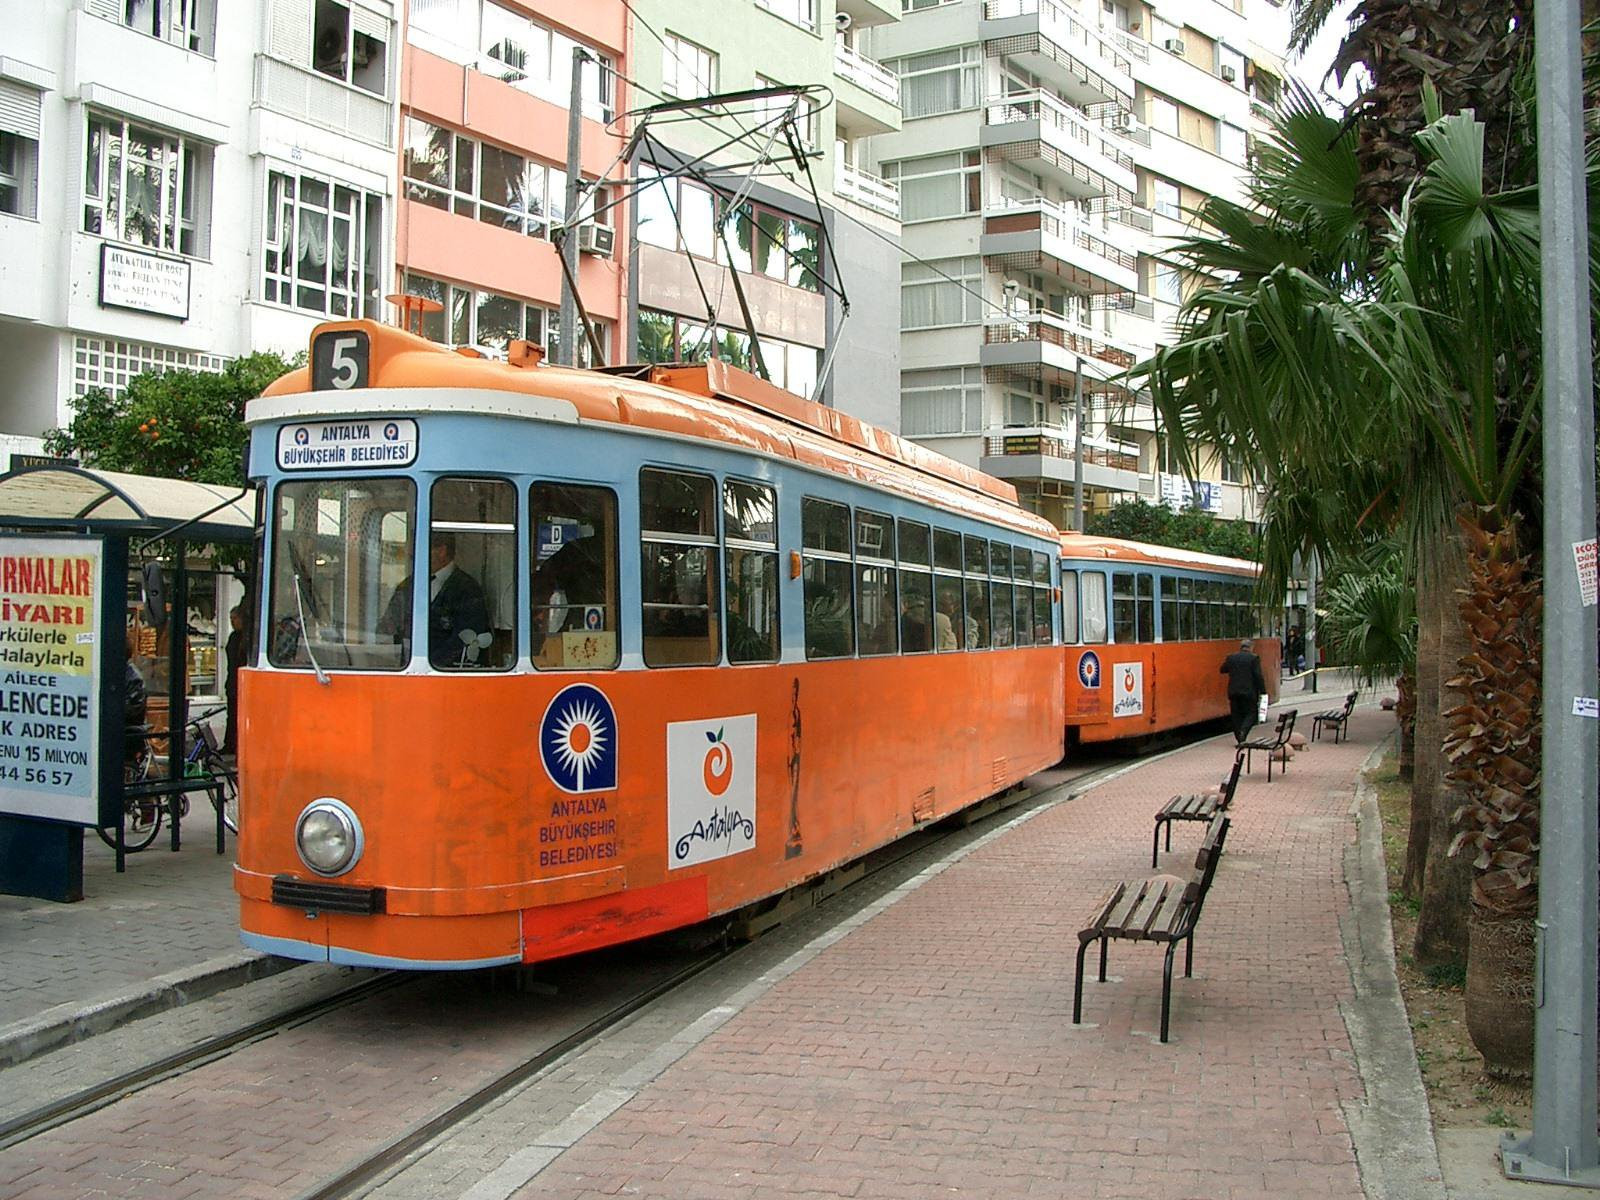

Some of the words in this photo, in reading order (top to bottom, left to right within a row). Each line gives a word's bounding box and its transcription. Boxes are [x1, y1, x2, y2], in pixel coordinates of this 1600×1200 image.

[331, 338, 359, 389] 5
[321, 424, 371, 441] ANTALYA
[284, 445, 346, 465] BÜYÜKŞEHİR
[351, 442, 409, 461] BELEDİYESİ
[553, 527, 560, 542] D
[0, 556, 90, 596] RNALAR
[4, 670, 57, 687] AİLECE
[0, 690, 88, 719] LENCEDE
[21, 722, 77, 741] ADRES
[25, 745, 40, 762] 15
[45, 747, 88, 766] MİLYON
[25, 768, 46, 783] 56
[52, 771, 73, 786] 57
[551, 797, 607, 817] ANTALYA
[540, 819, 616, 843] BÜYÜKŞEHİR
[540, 841, 617, 867] BELEDİYESİ
